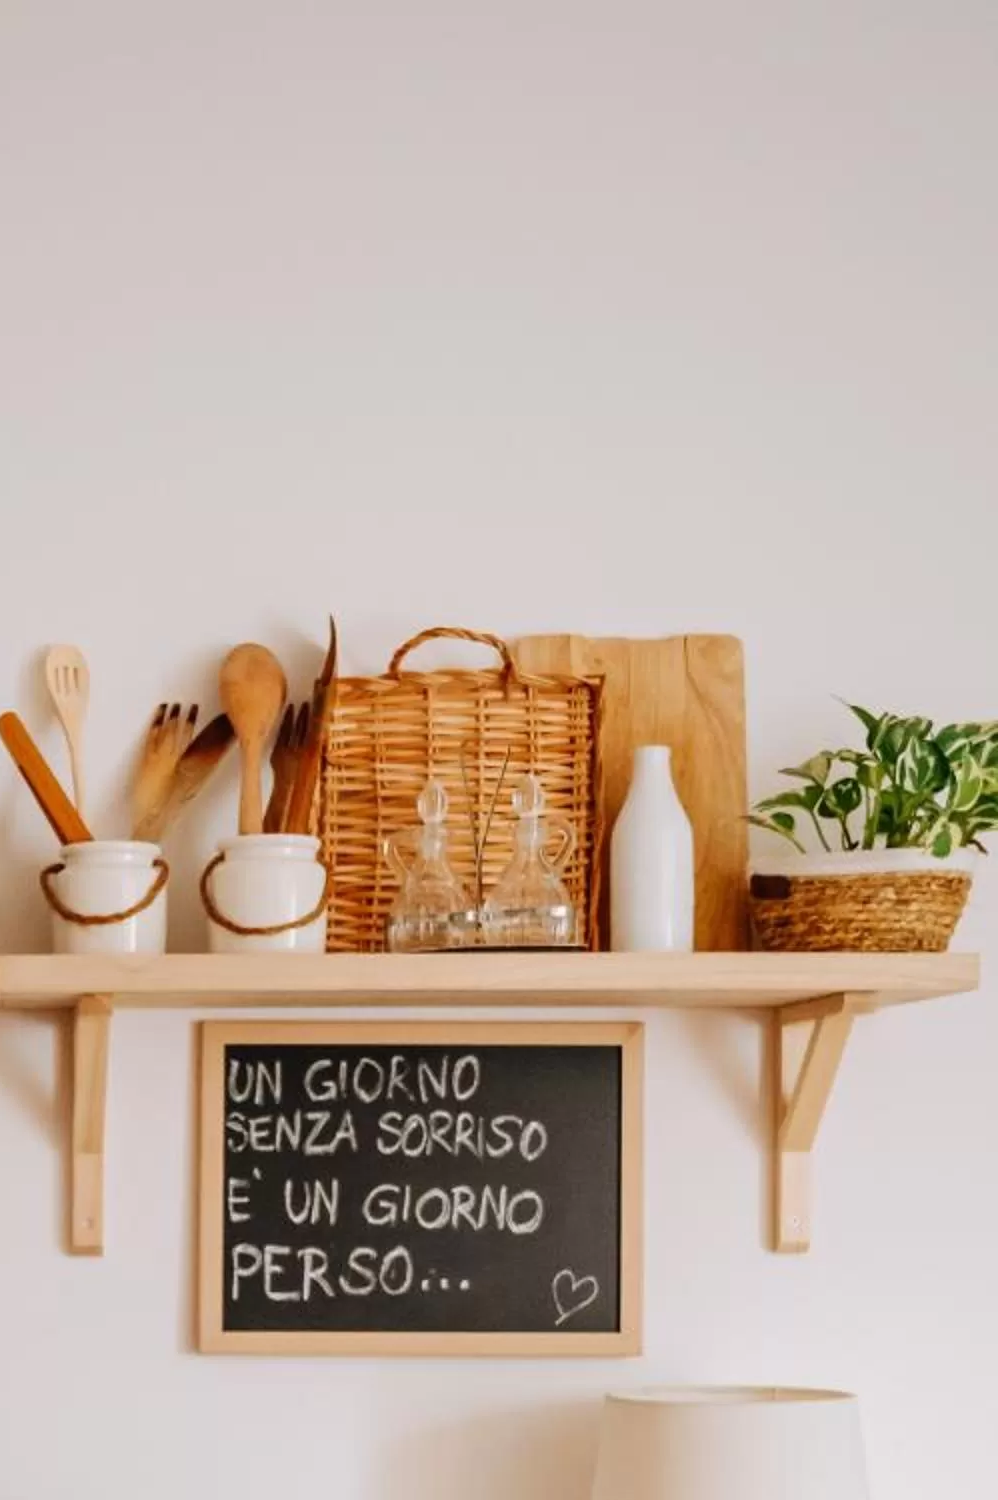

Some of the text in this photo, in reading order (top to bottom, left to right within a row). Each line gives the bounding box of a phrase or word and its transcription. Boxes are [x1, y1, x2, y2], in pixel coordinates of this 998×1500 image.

[227, 1054, 481, 1105] UN GIORNO
[226, 1110, 548, 1162] SENZA SORRISO
[284, 1178, 340, 1226] UN
[362, 1184, 544, 1235] GIORNO
